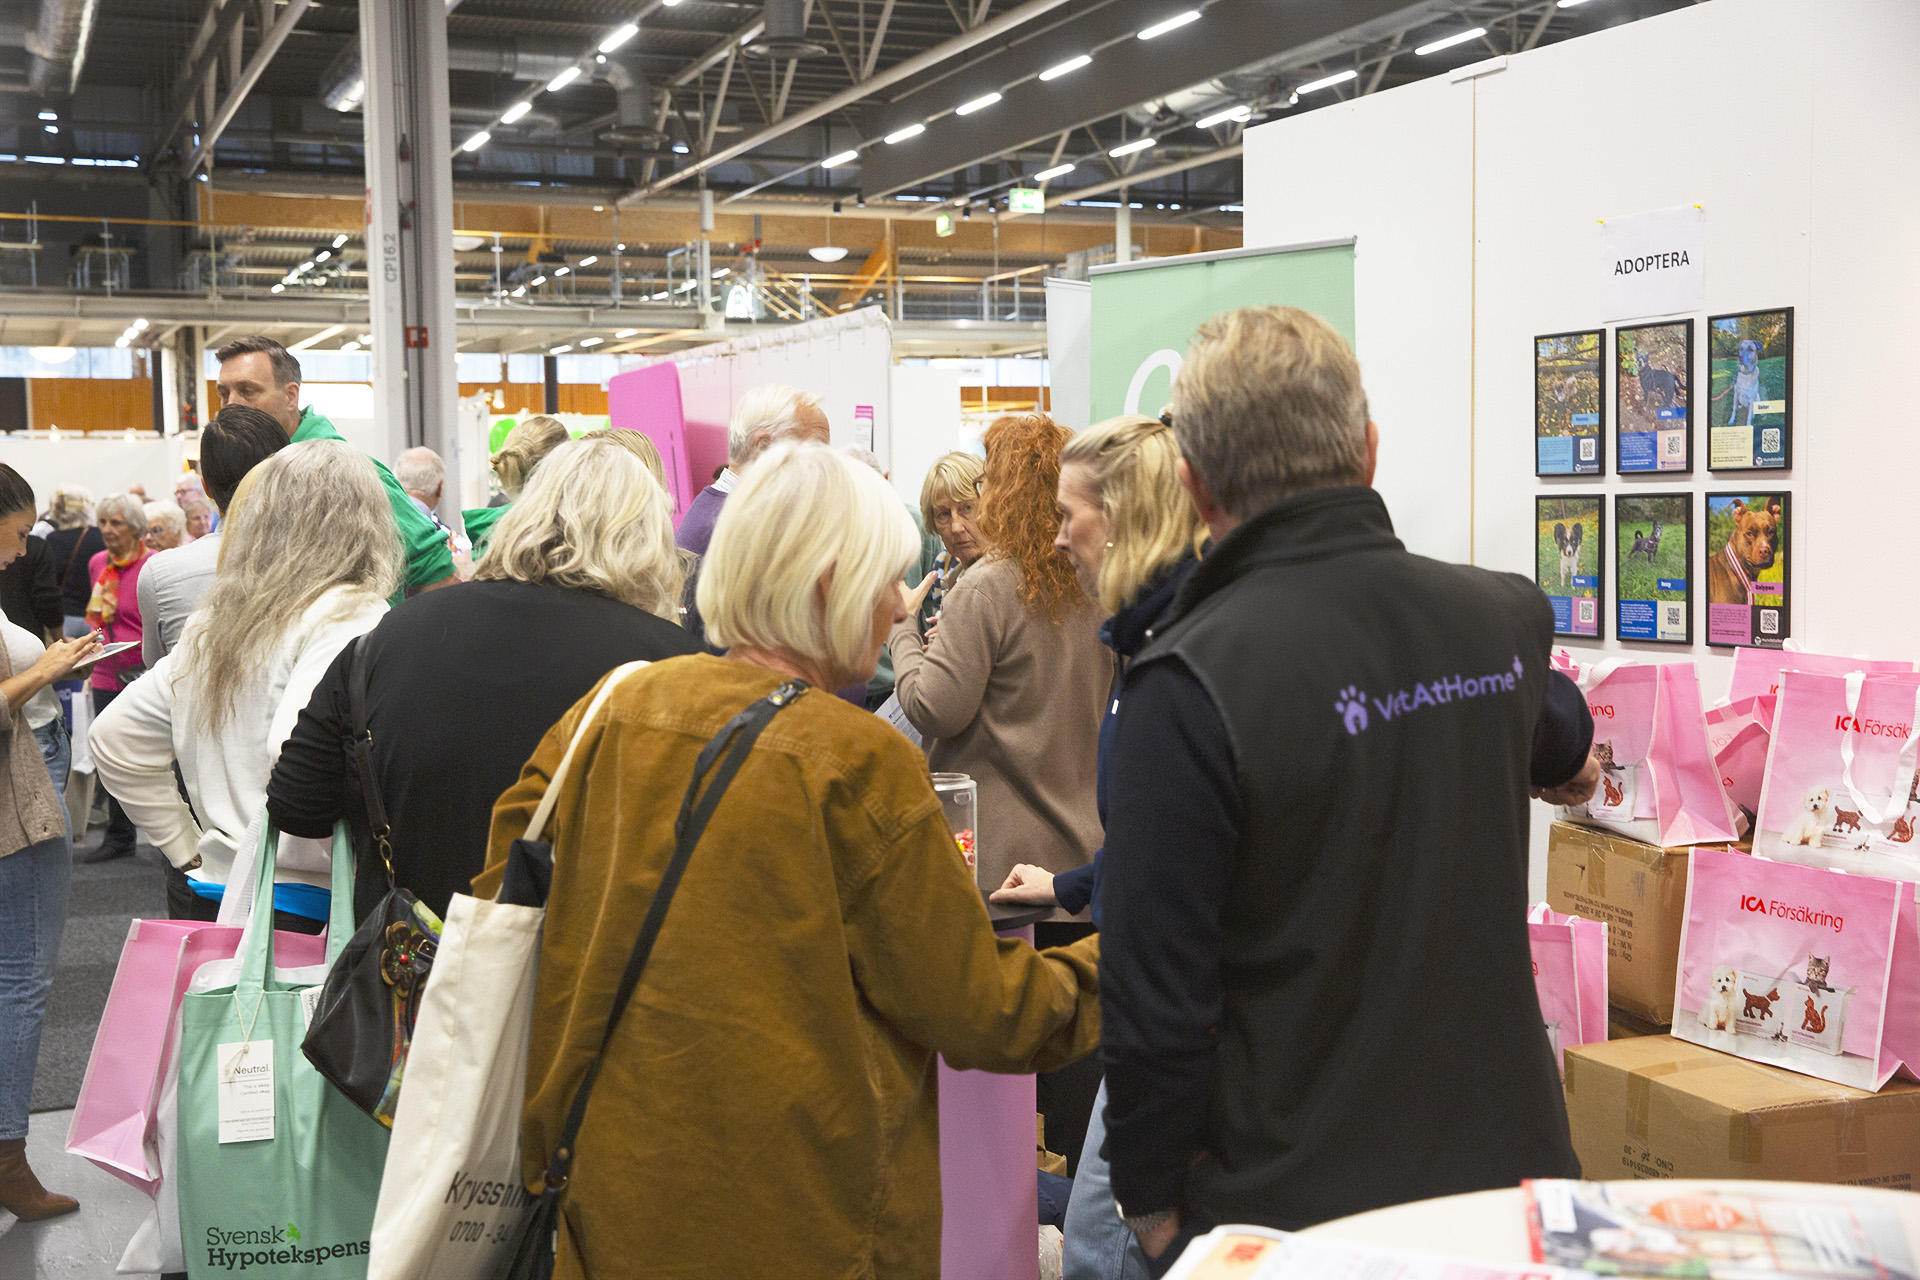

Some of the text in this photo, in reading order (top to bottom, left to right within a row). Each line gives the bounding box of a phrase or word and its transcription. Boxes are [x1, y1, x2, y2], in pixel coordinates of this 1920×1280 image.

[1614, 251, 1689, 275] ADOPTERA
[1835, 715, 1860, 733] ICA
[1740, 894, 1843, 933] ICA Försäkring
[207, 1226, 285, 1245] Svensk
[450, 1221, 485, 1242] 0700
[207, 1241, 370, 1270] Hypotekspens
